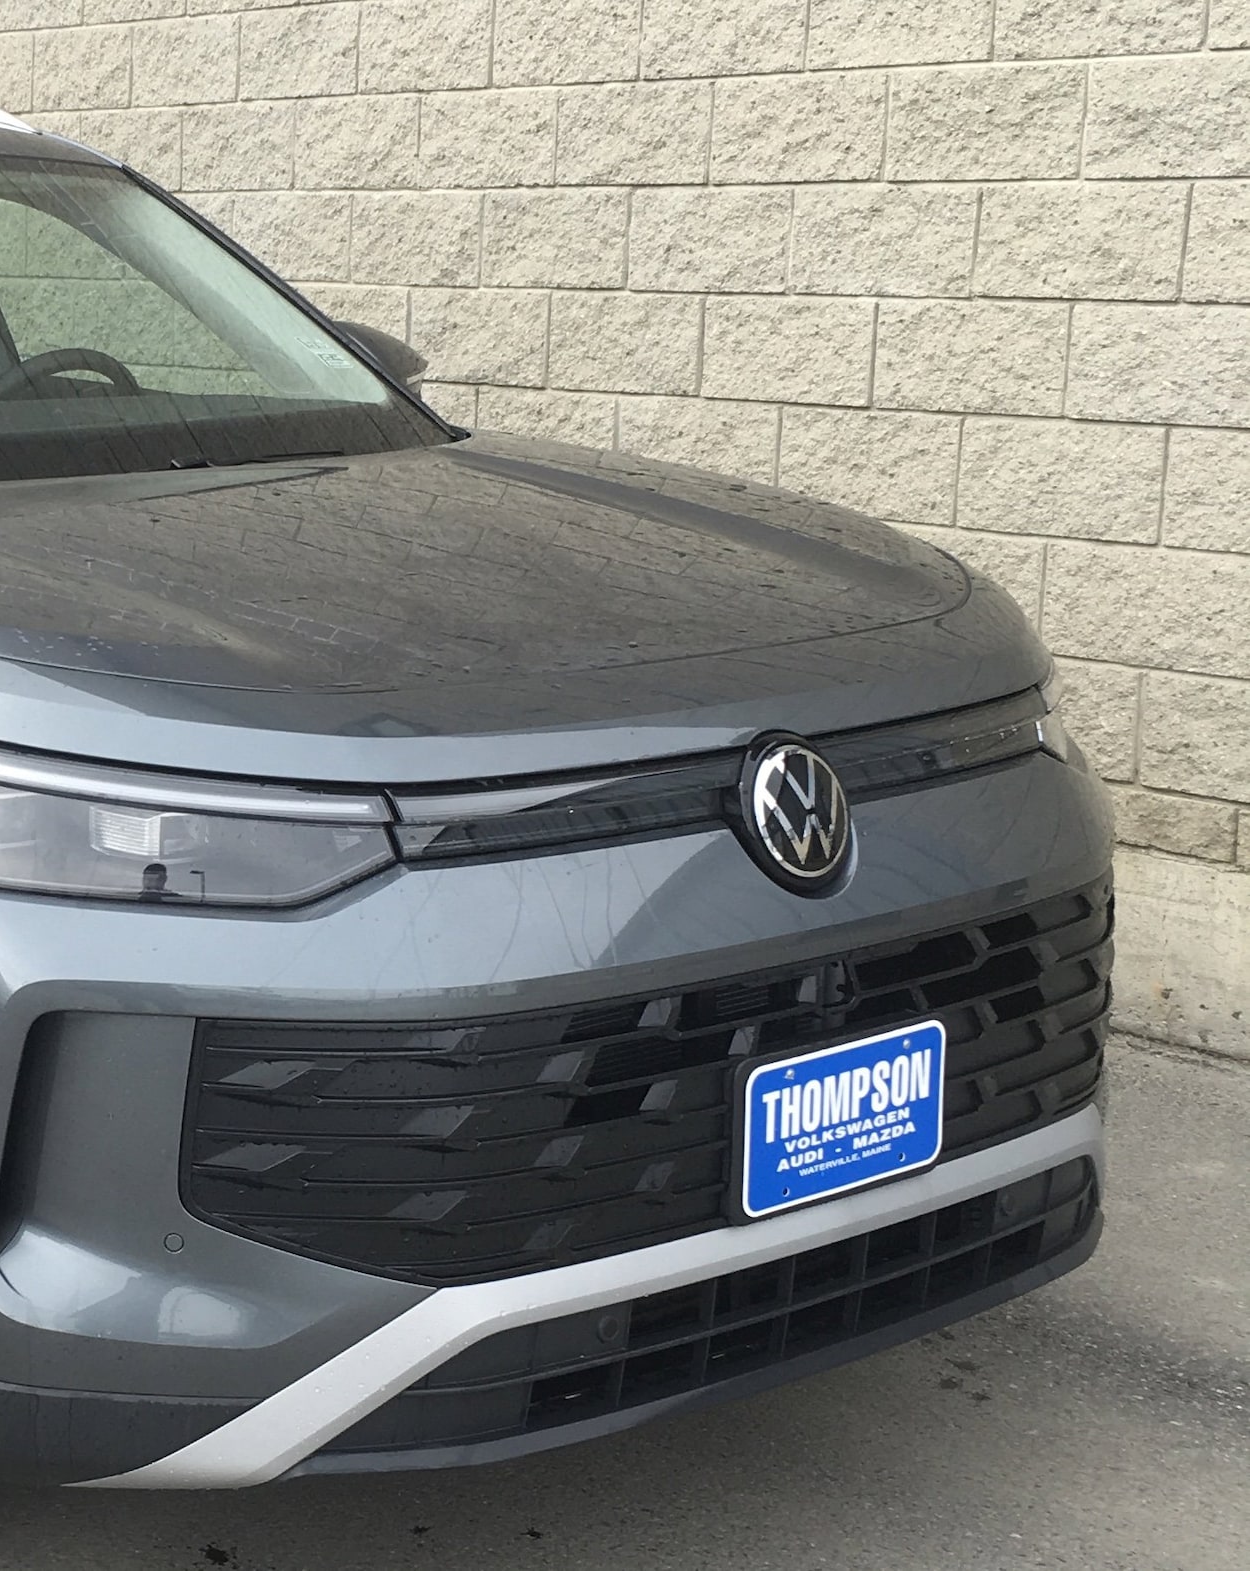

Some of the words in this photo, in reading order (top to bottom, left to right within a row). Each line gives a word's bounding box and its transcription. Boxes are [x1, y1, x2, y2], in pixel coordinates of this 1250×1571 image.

[762, 1048, 932, 1144] THOMPSON
[776, 1148, 824, 1172] AUDI
[852, 1121, 917, 1150] MAZDA
[784, 1107, 911, 1153] VOLKSWAGEN
[861, 1143, 892, 1158] MAINE
